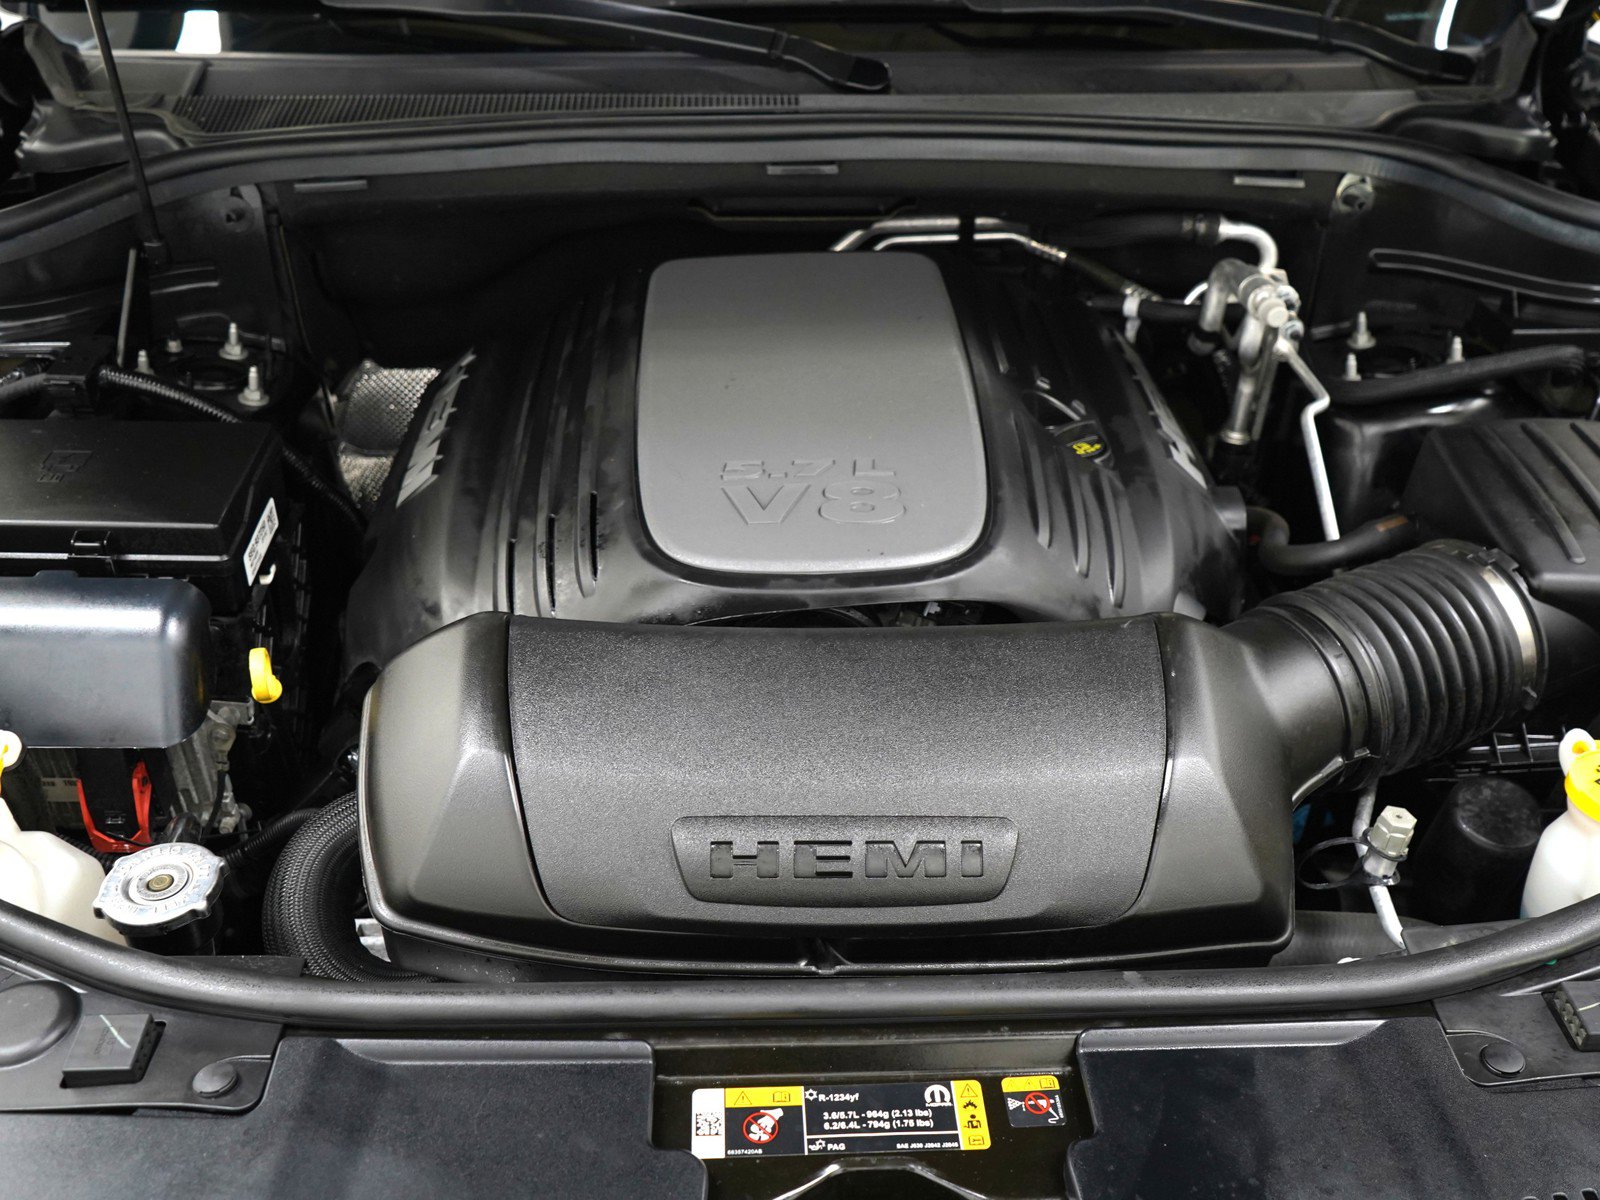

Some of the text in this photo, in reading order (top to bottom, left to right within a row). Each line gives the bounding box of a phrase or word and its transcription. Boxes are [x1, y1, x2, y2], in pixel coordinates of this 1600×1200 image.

[720, 480, 907, 526] V8
[710, 840, 983, 878] HEMI
[818, 1092, 860, 1103] R-1234yf
[823, 1109, 860, 1121] 3.6/5.7L
[891, 1108, 914, 1119] (2.13
[915, 1108, 933, 1118] lbs)
[823, 1120, 861, 1131] 6.2/6.4L
[867, 1120, 891, 1130] 794g
[892, 1119, 915, 1130] (1.75
[916, 1118, 934, 1129] lbs)
[827, 1143, 846, 1151] PAG
